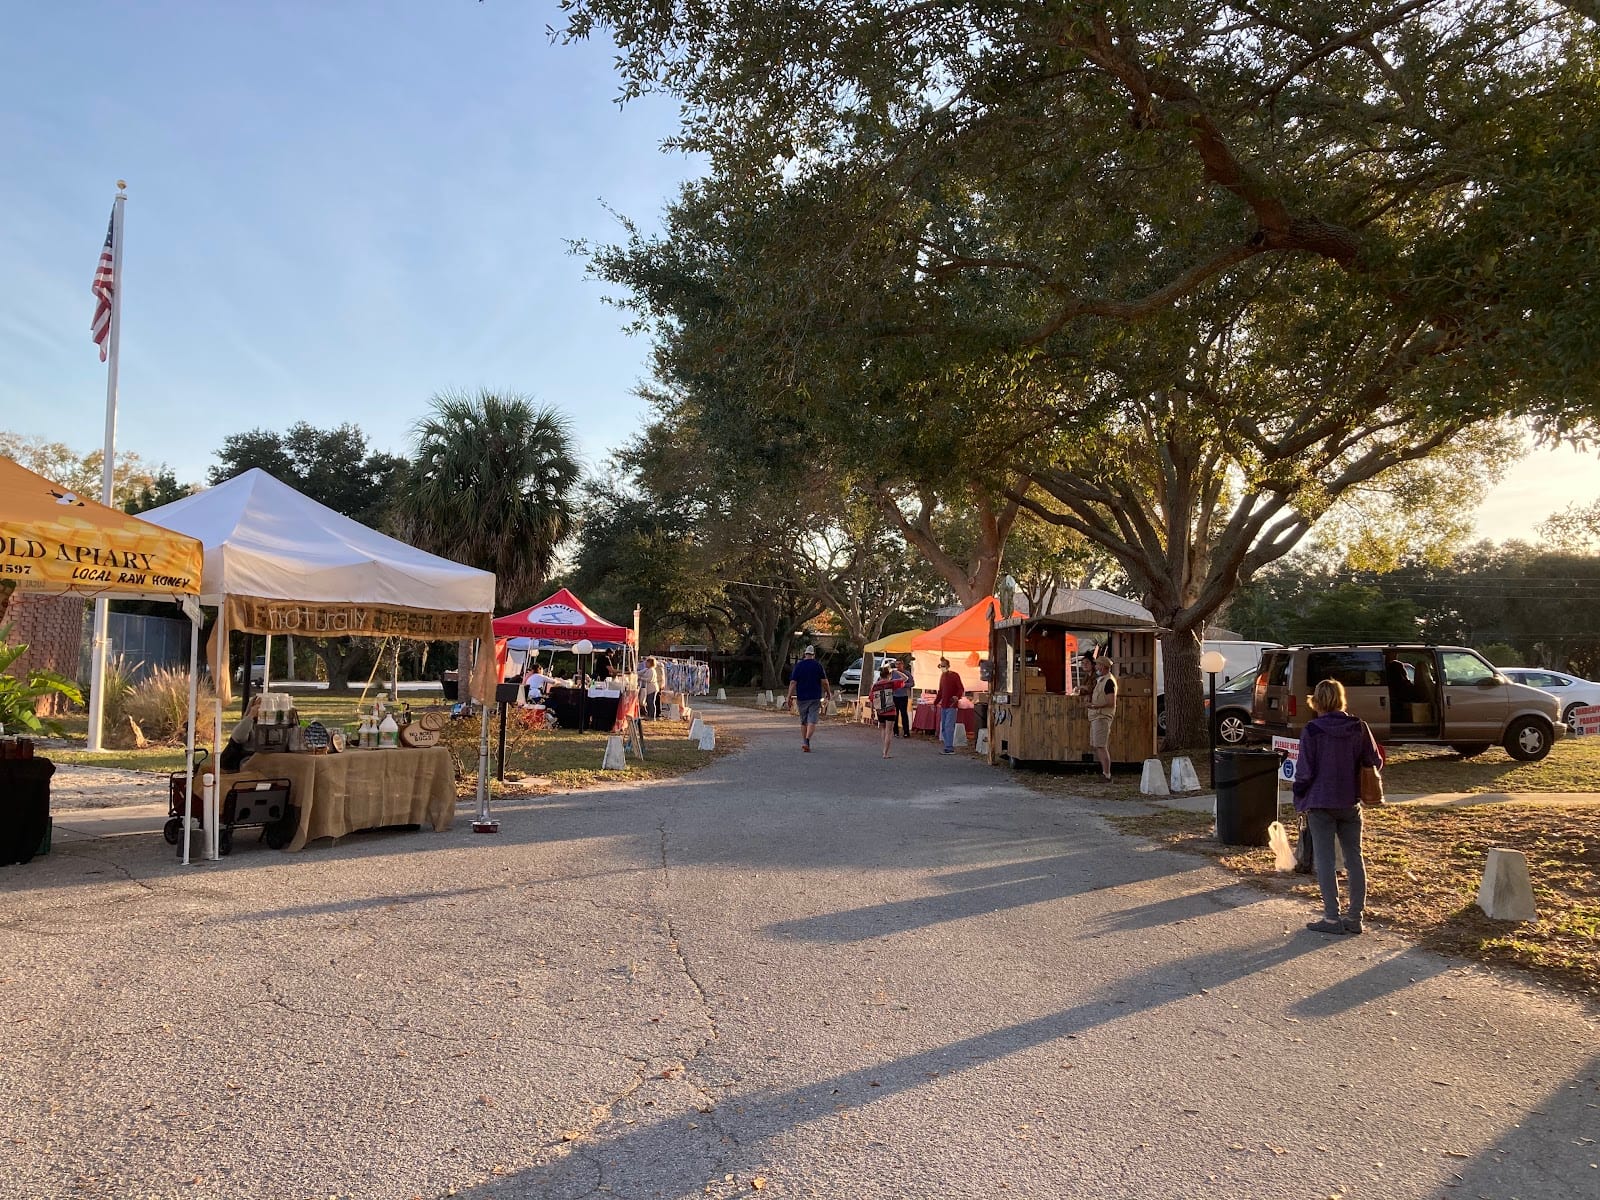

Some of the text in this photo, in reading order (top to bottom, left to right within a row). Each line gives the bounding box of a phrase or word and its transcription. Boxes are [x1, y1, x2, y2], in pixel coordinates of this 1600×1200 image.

[56, 543, 156, 570] APIARY
[72, 567, 191, 588] LOCAL RAW HONEY
[268, 607, 367, 631] naturally
[518, 626, 589, 638] MAGIC CREPES
